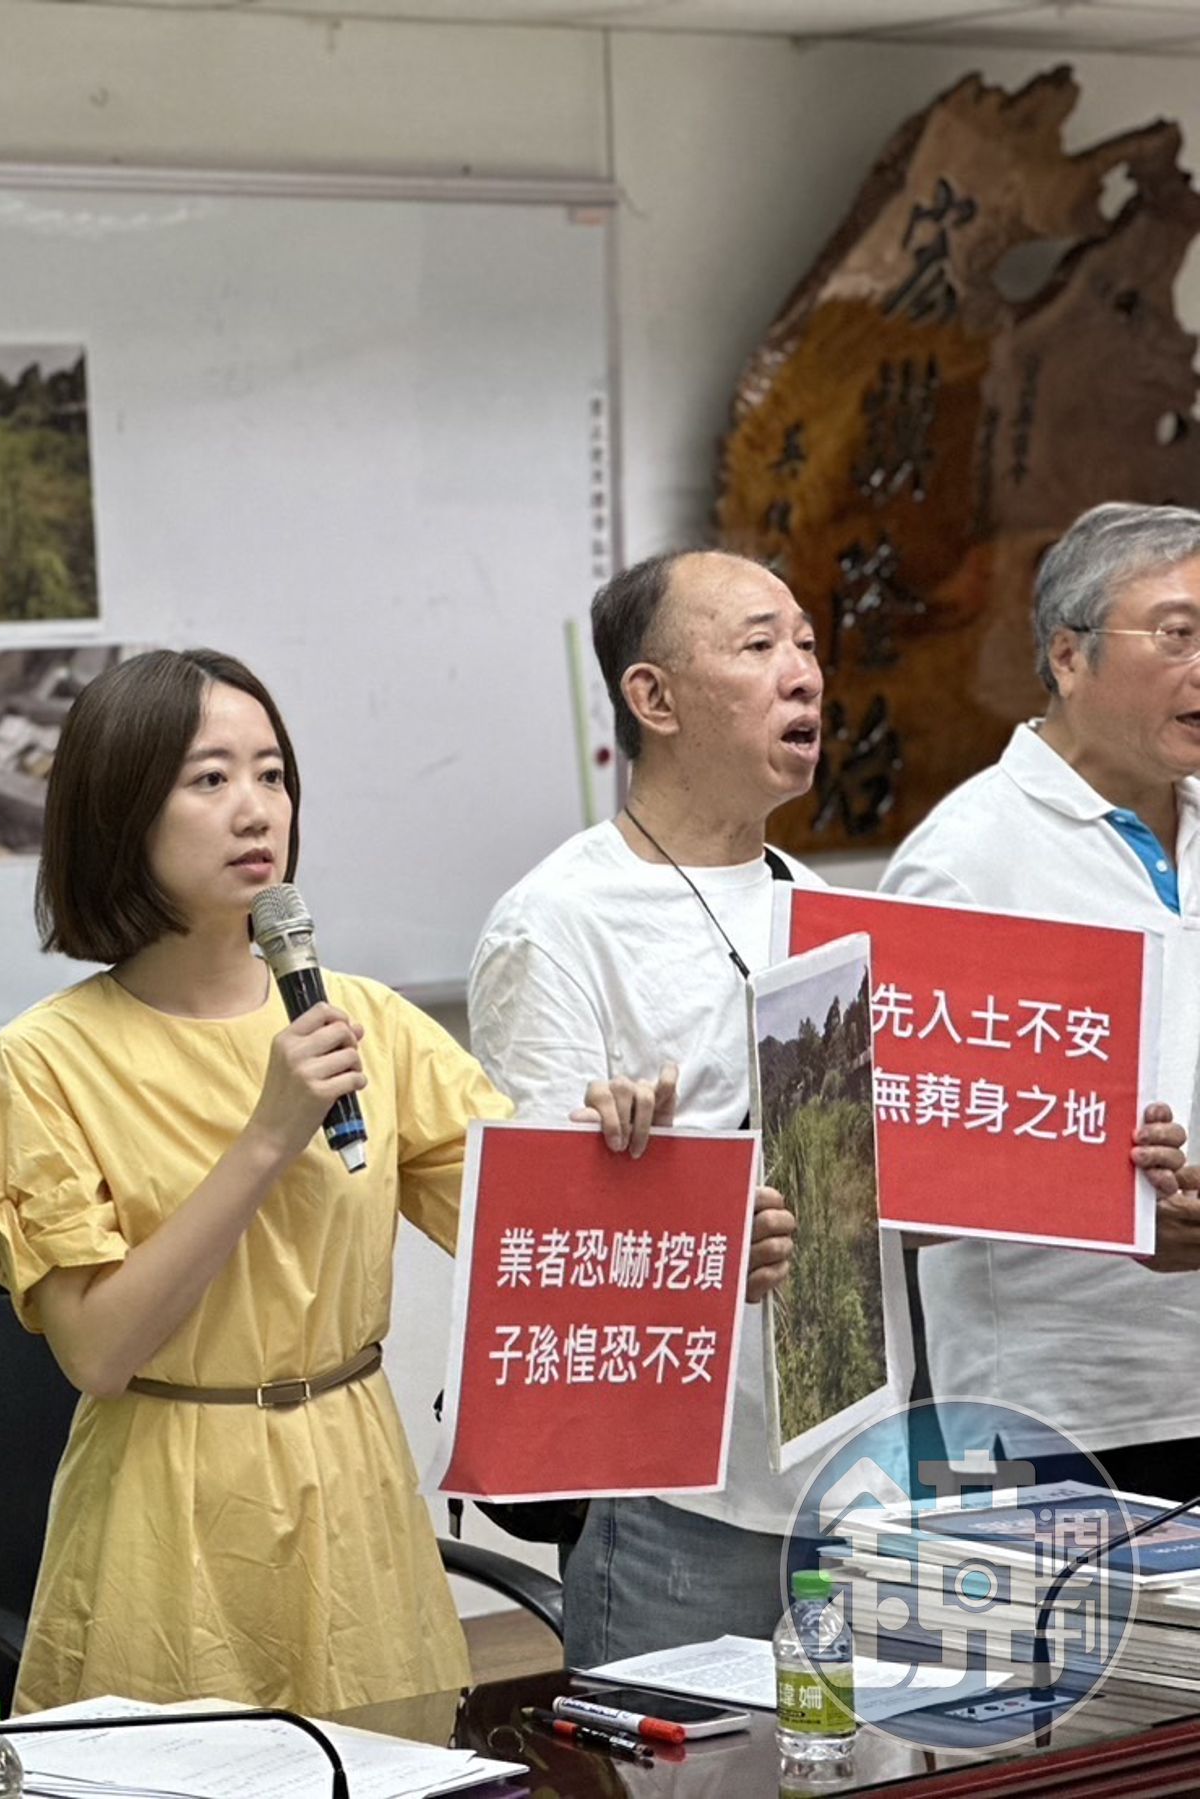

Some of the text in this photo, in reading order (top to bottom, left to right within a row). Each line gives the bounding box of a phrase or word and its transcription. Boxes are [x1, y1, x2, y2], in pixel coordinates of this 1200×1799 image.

[871, 982, 1111, 1062] 先入土不安
[872, 1066, 1107, 1145] 無葬身之地
[496, 1226, 728, 1291] 業者恐嚇挖墳
[488, 1323, 717, 1386] 子孫惶恐不安
